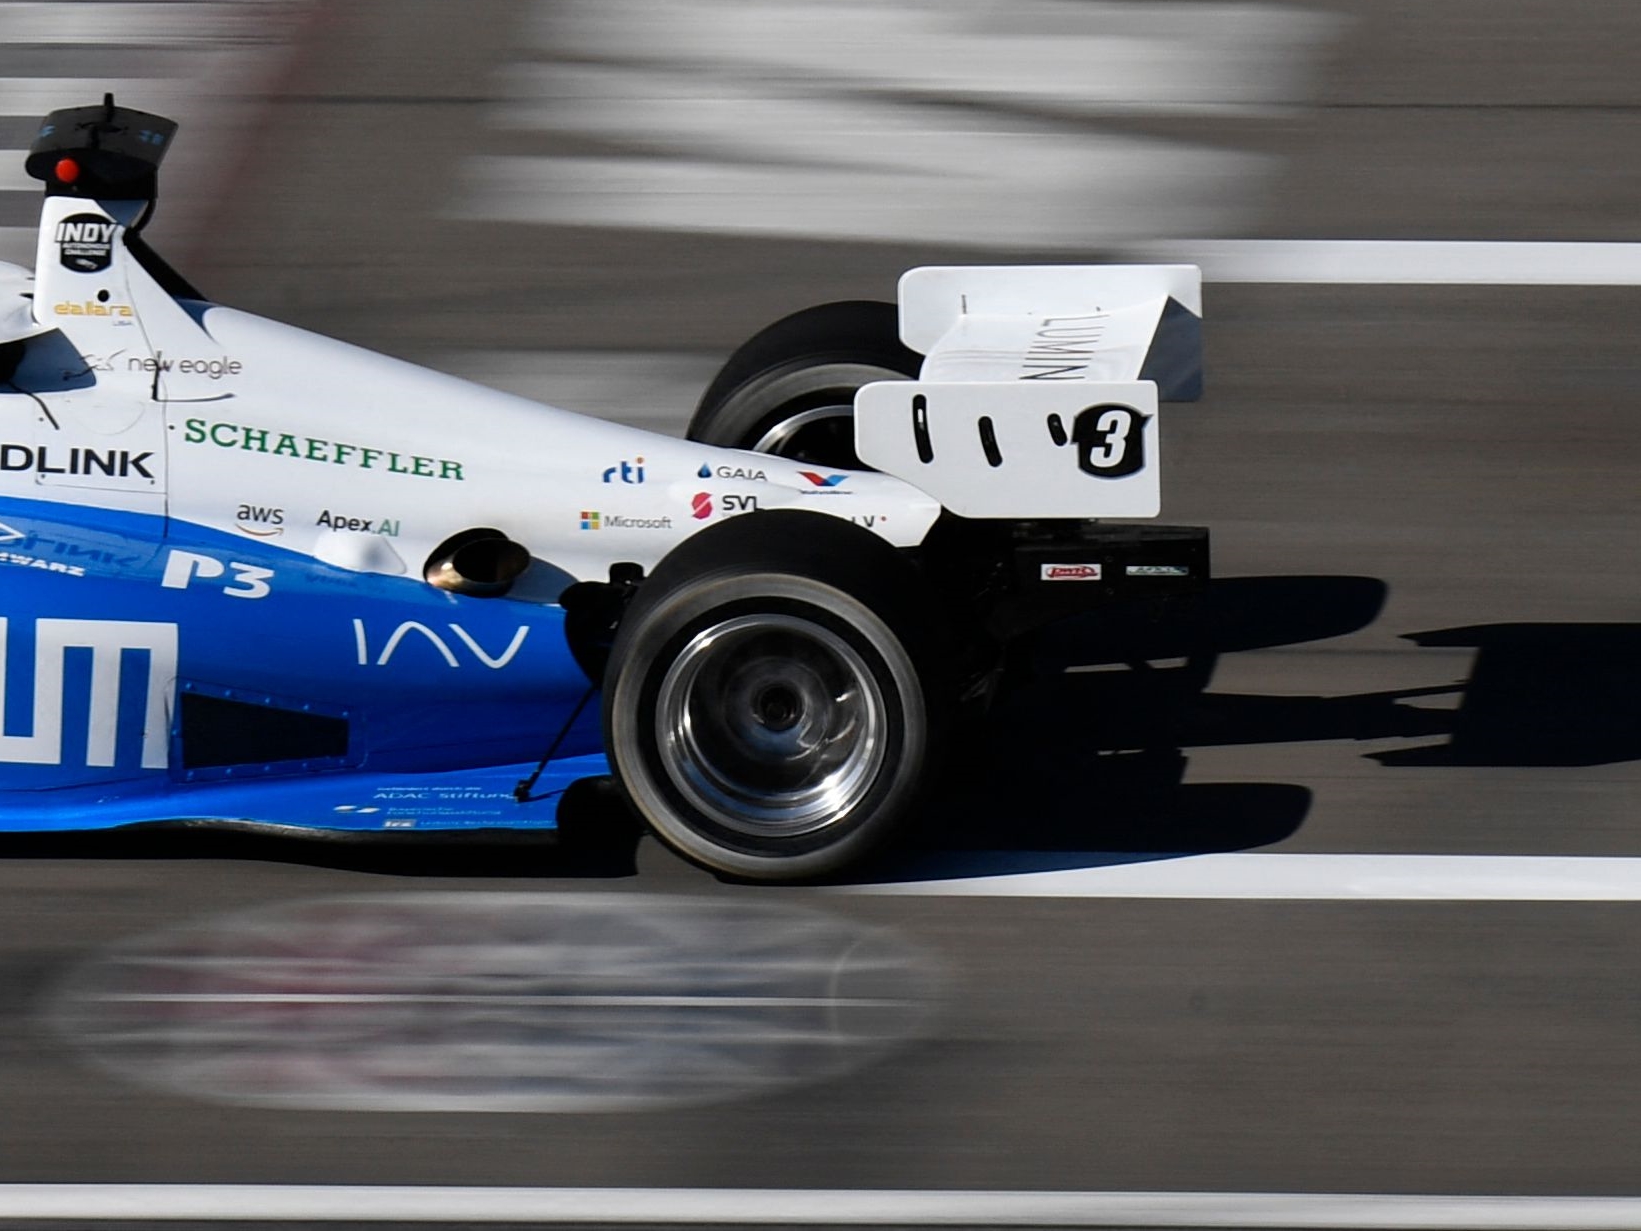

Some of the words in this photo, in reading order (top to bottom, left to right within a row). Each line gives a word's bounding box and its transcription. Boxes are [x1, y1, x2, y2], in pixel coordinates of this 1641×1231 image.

[56, 222, 116, 242] INDY
[53, 300, 133, 317] dallara
[128, 356, 174, 373] new
[179, 355, 243, 380] eagle
[185, 418, 465, 481] SCHAEFFLER
[1089, 409, 1132, 468] 3
[602, 457, 645, 485] rti
[716, 465, 768, 482] GAIA
[237, 504, 284, 525] aws
[316, 510, 400, 538] Apex.AI
[604, 514, 672, 530] Microsoft
[161, 549, 275, 600] P3
